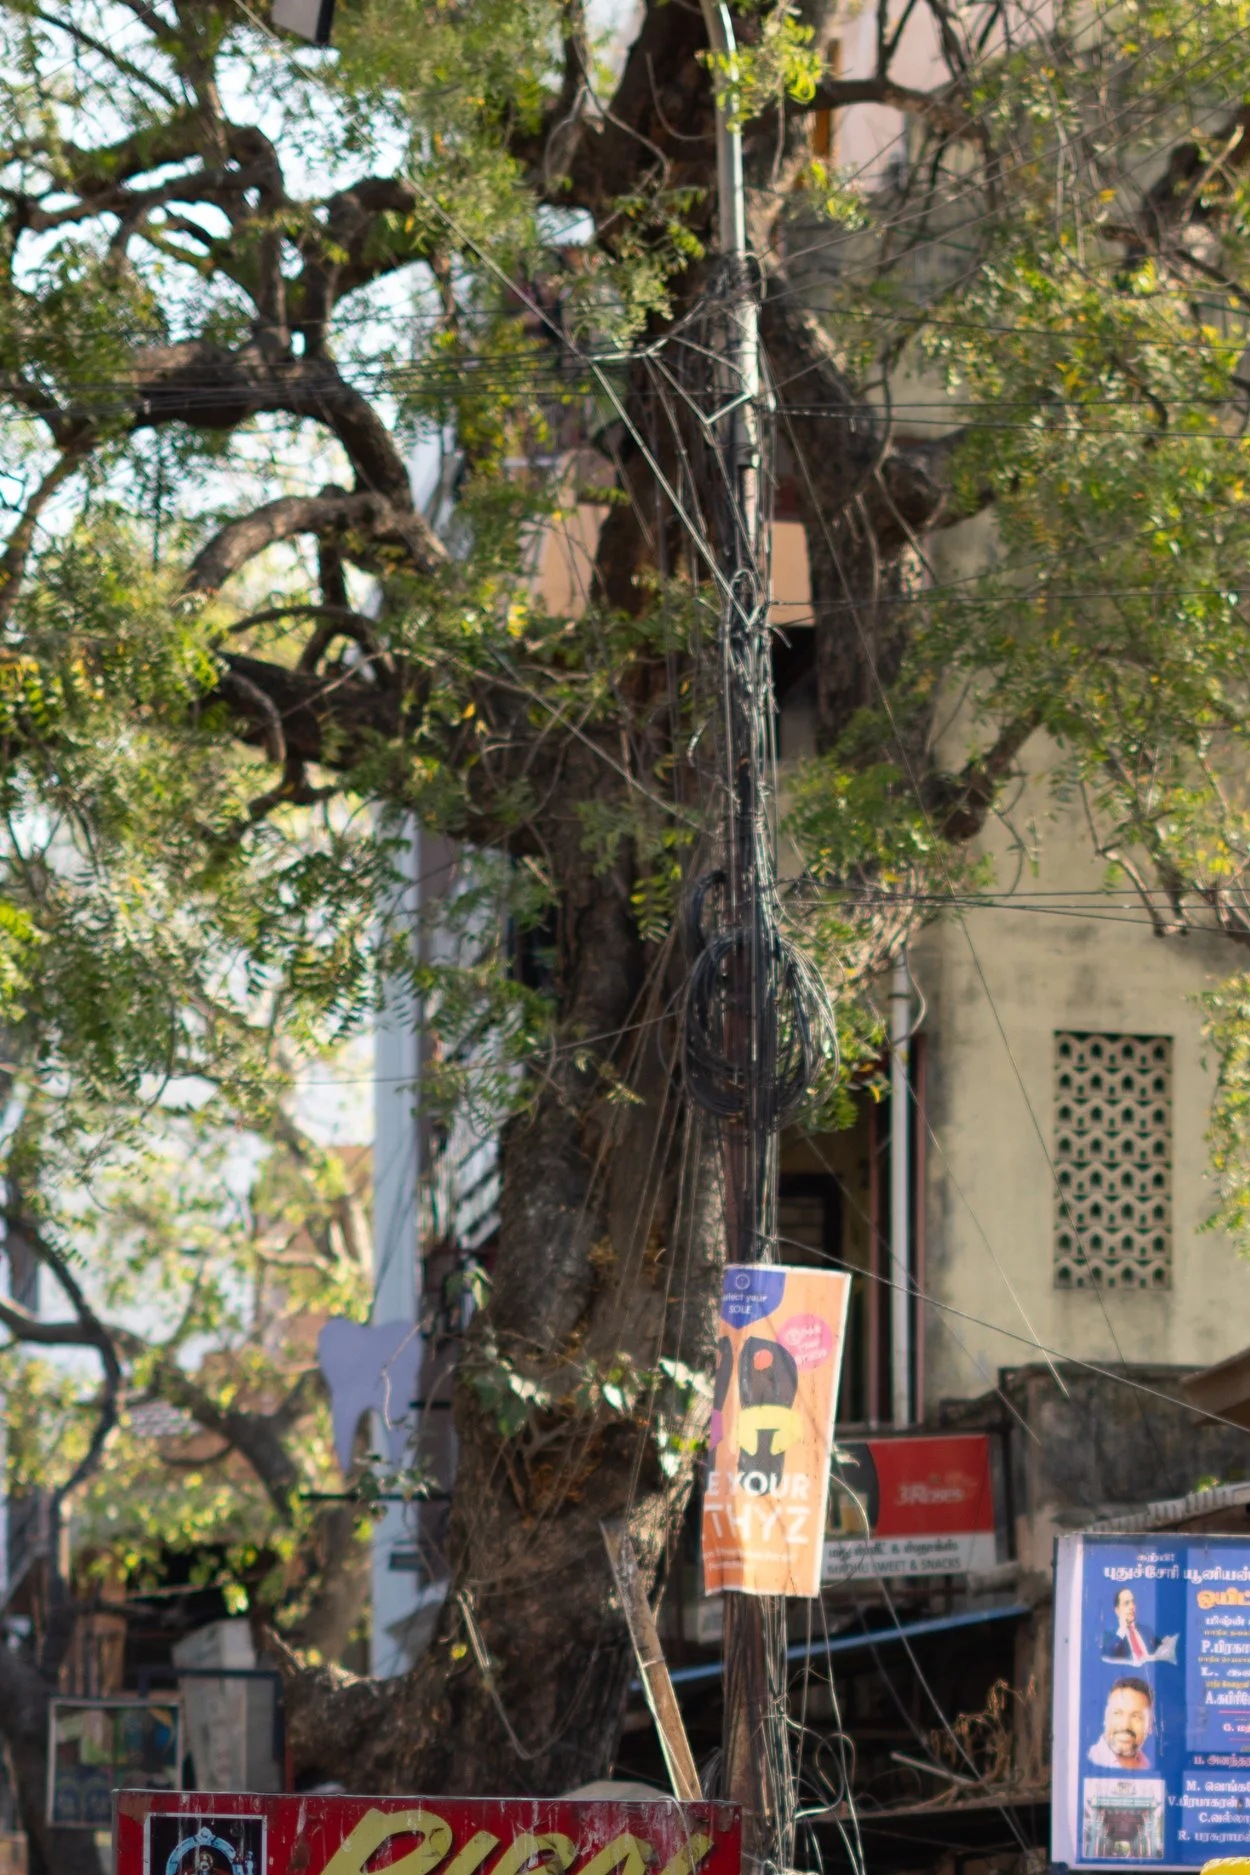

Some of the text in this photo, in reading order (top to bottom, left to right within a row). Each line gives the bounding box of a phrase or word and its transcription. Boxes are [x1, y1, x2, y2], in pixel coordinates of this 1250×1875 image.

[728, 1305, 752, 1315] SOLE
[726, 1471, 811, 1499] YOUR
[871, 1560, 906, 1572] SWEET
[910, 1559, 917, 1570] &
[921, 1557, 961, 1570] SNACKS
[1104, 1564, 1179, 1582] புதுச்சேரி
